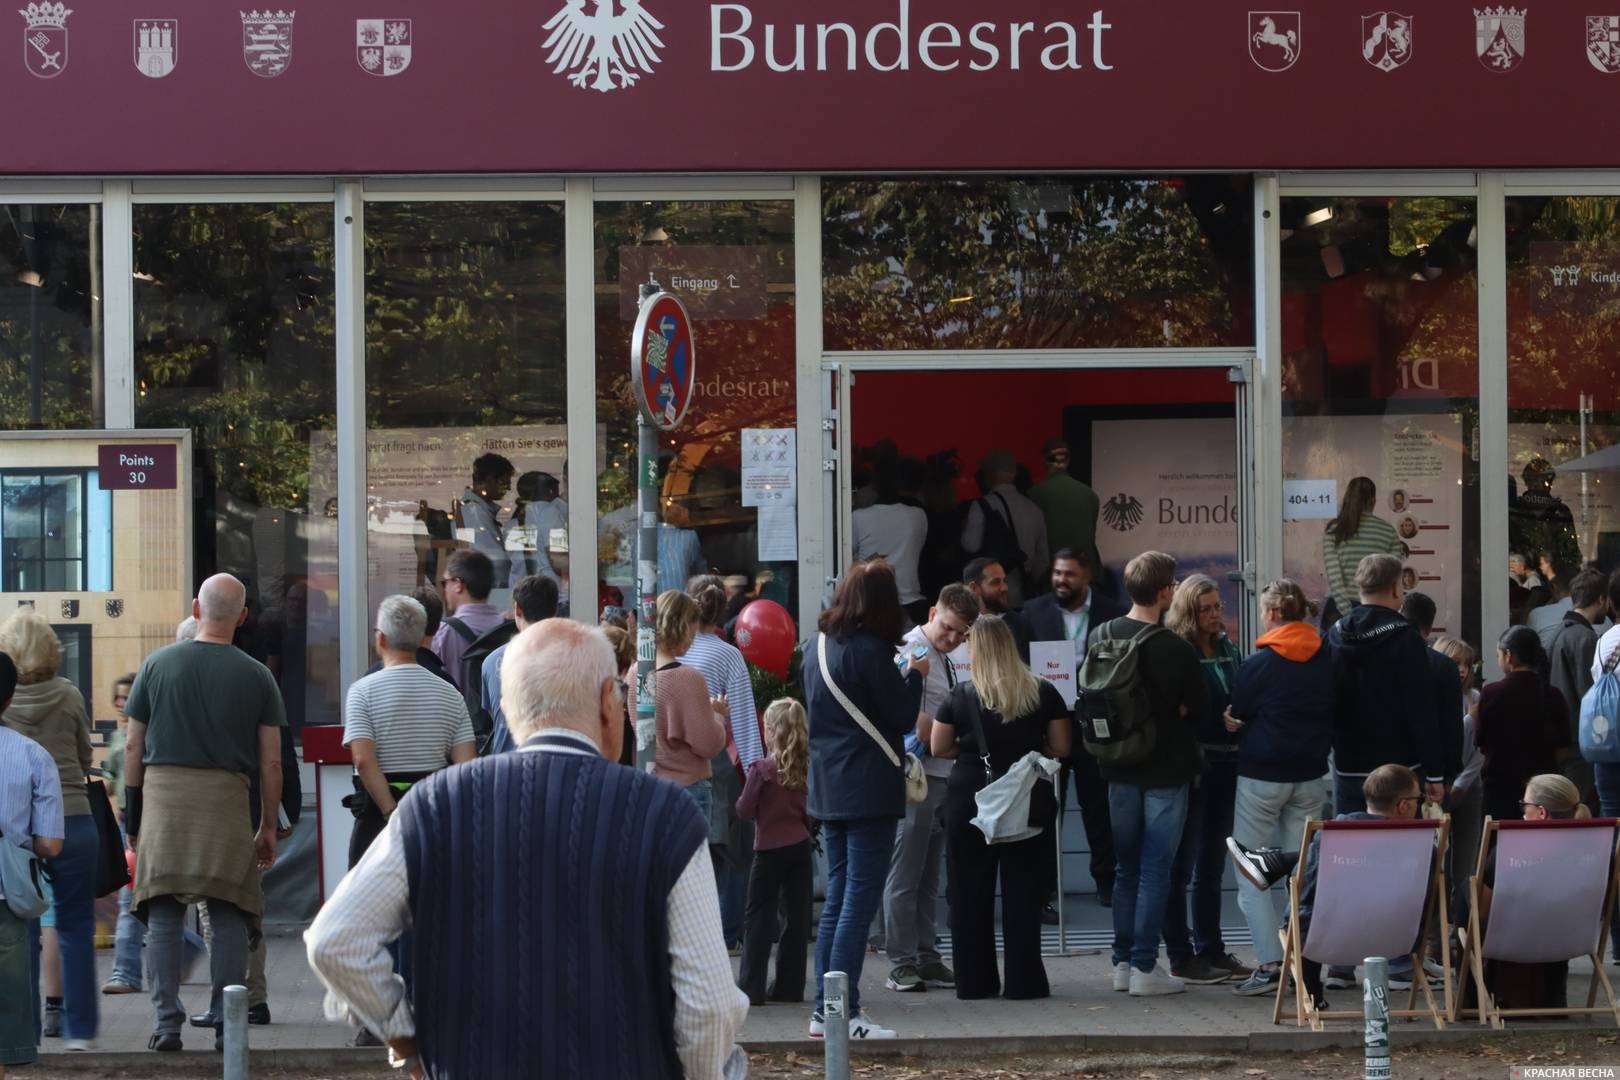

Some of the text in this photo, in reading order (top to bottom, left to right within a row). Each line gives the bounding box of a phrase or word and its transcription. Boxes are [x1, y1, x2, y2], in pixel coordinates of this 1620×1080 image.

[710, 0, 1114, 72] Bundesrat
[671, 276, 718, 291] Eingang
[693, 375, 780, 398] ndesrat
[119, 453, 154, 466] Points
[129, 471, 146, 484] 30
[1288, 494, 1308, 505] 404
[1318, 494, 1331, 504] 11
[1158, 495, 1237, 525] Bunde
[1047, 661, 1060, 669] Nur
[852, 1025, 870, 1039] N
